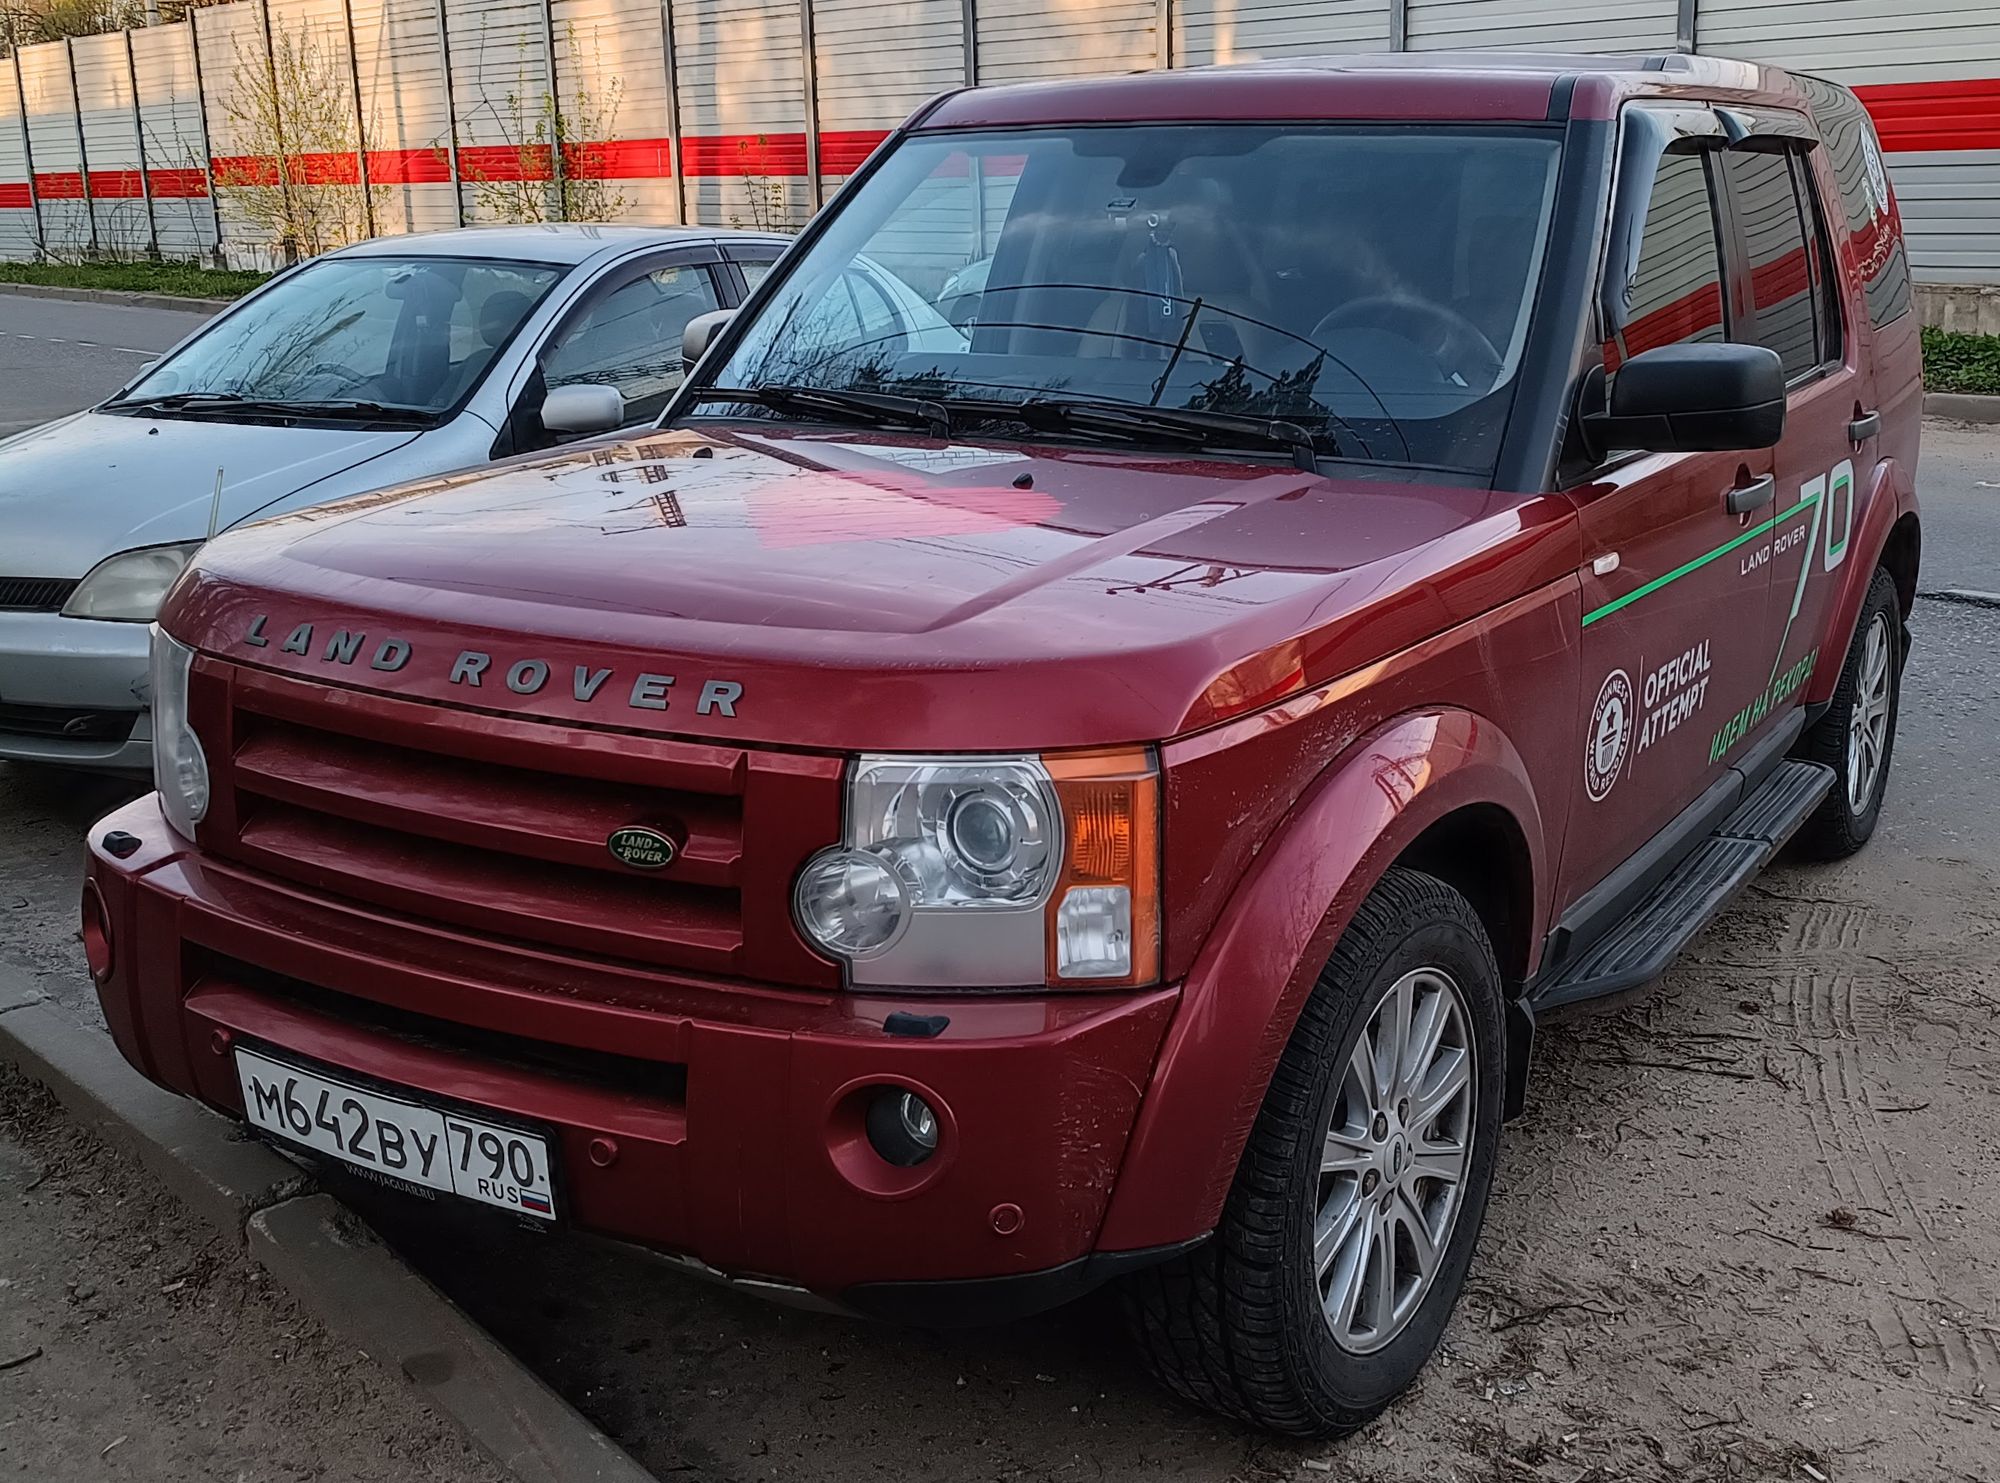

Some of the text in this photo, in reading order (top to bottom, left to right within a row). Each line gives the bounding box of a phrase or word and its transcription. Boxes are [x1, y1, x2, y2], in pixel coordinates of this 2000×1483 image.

[1741, 525, 1806, 576] LAND ROVER
[1790, 458, 1854, 622] 70
[243, 614, 744, 717] LAND ROVER
[1644, 638, 1711, 709] OFFICIAL
[1596, 679, 1628, 721] GUINNESS
[1637, 675, 1710, 754] ATTEMPT
[1750, 689, 1769, 727] НА
[620, 834, 653, 850] LAND
[623, 846, 663, 863] ROVER
[449, 1123, 534, 1188] 790
[477, 1180, 519, 1204] RUS
